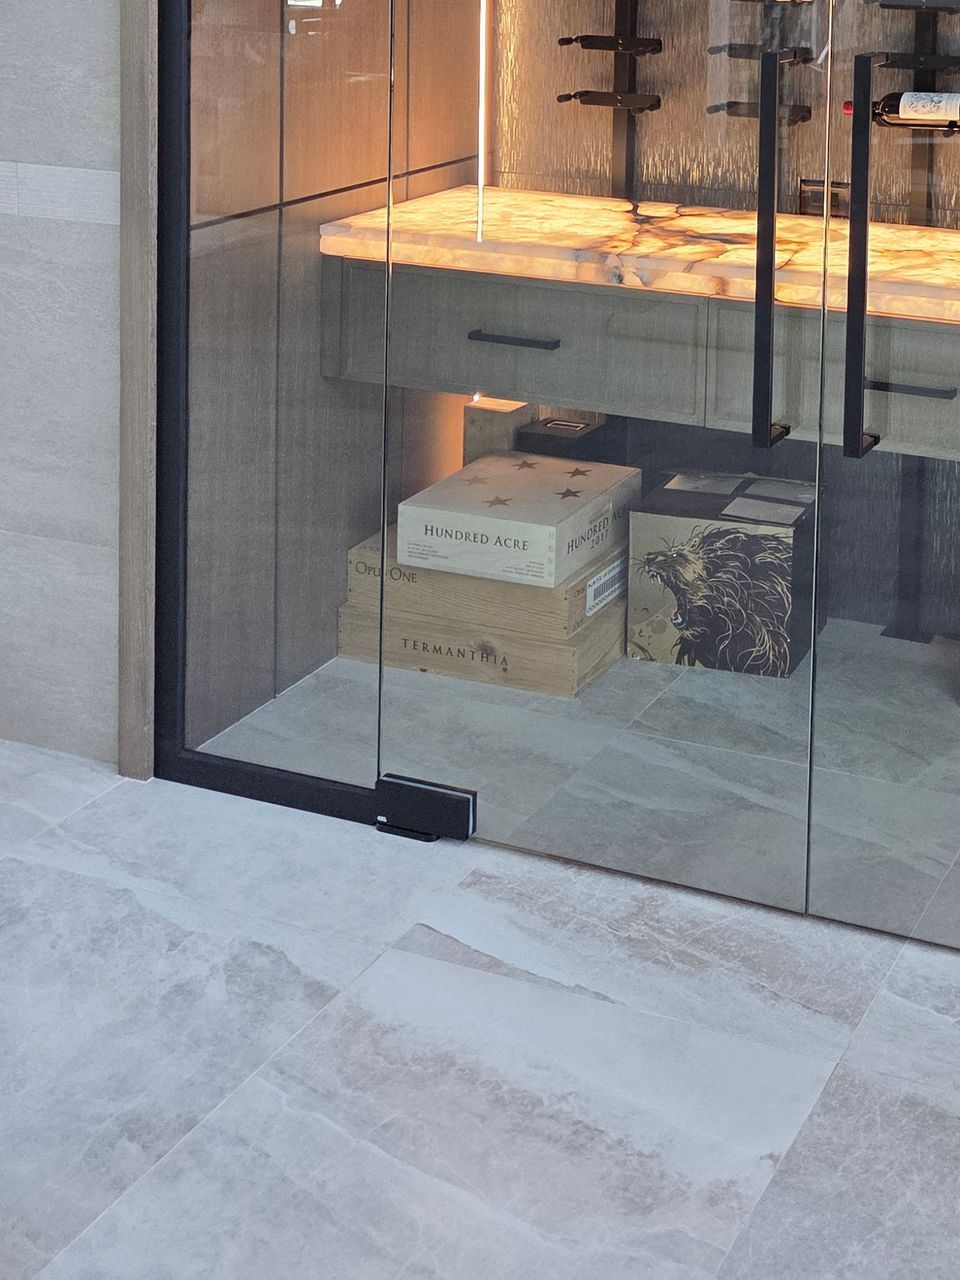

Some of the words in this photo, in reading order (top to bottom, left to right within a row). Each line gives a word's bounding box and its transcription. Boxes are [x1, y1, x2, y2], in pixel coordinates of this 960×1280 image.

[424, 524, 489, 544] HUNDRED
[494, 535, 529, 551] ACRE
[567, 517, 609, 555] HUNDRED
[355, 561, 387, 577] OPU
[390, 567, 417, 583] ONE
[401, 638, 509, 666] TERMANTHIA
